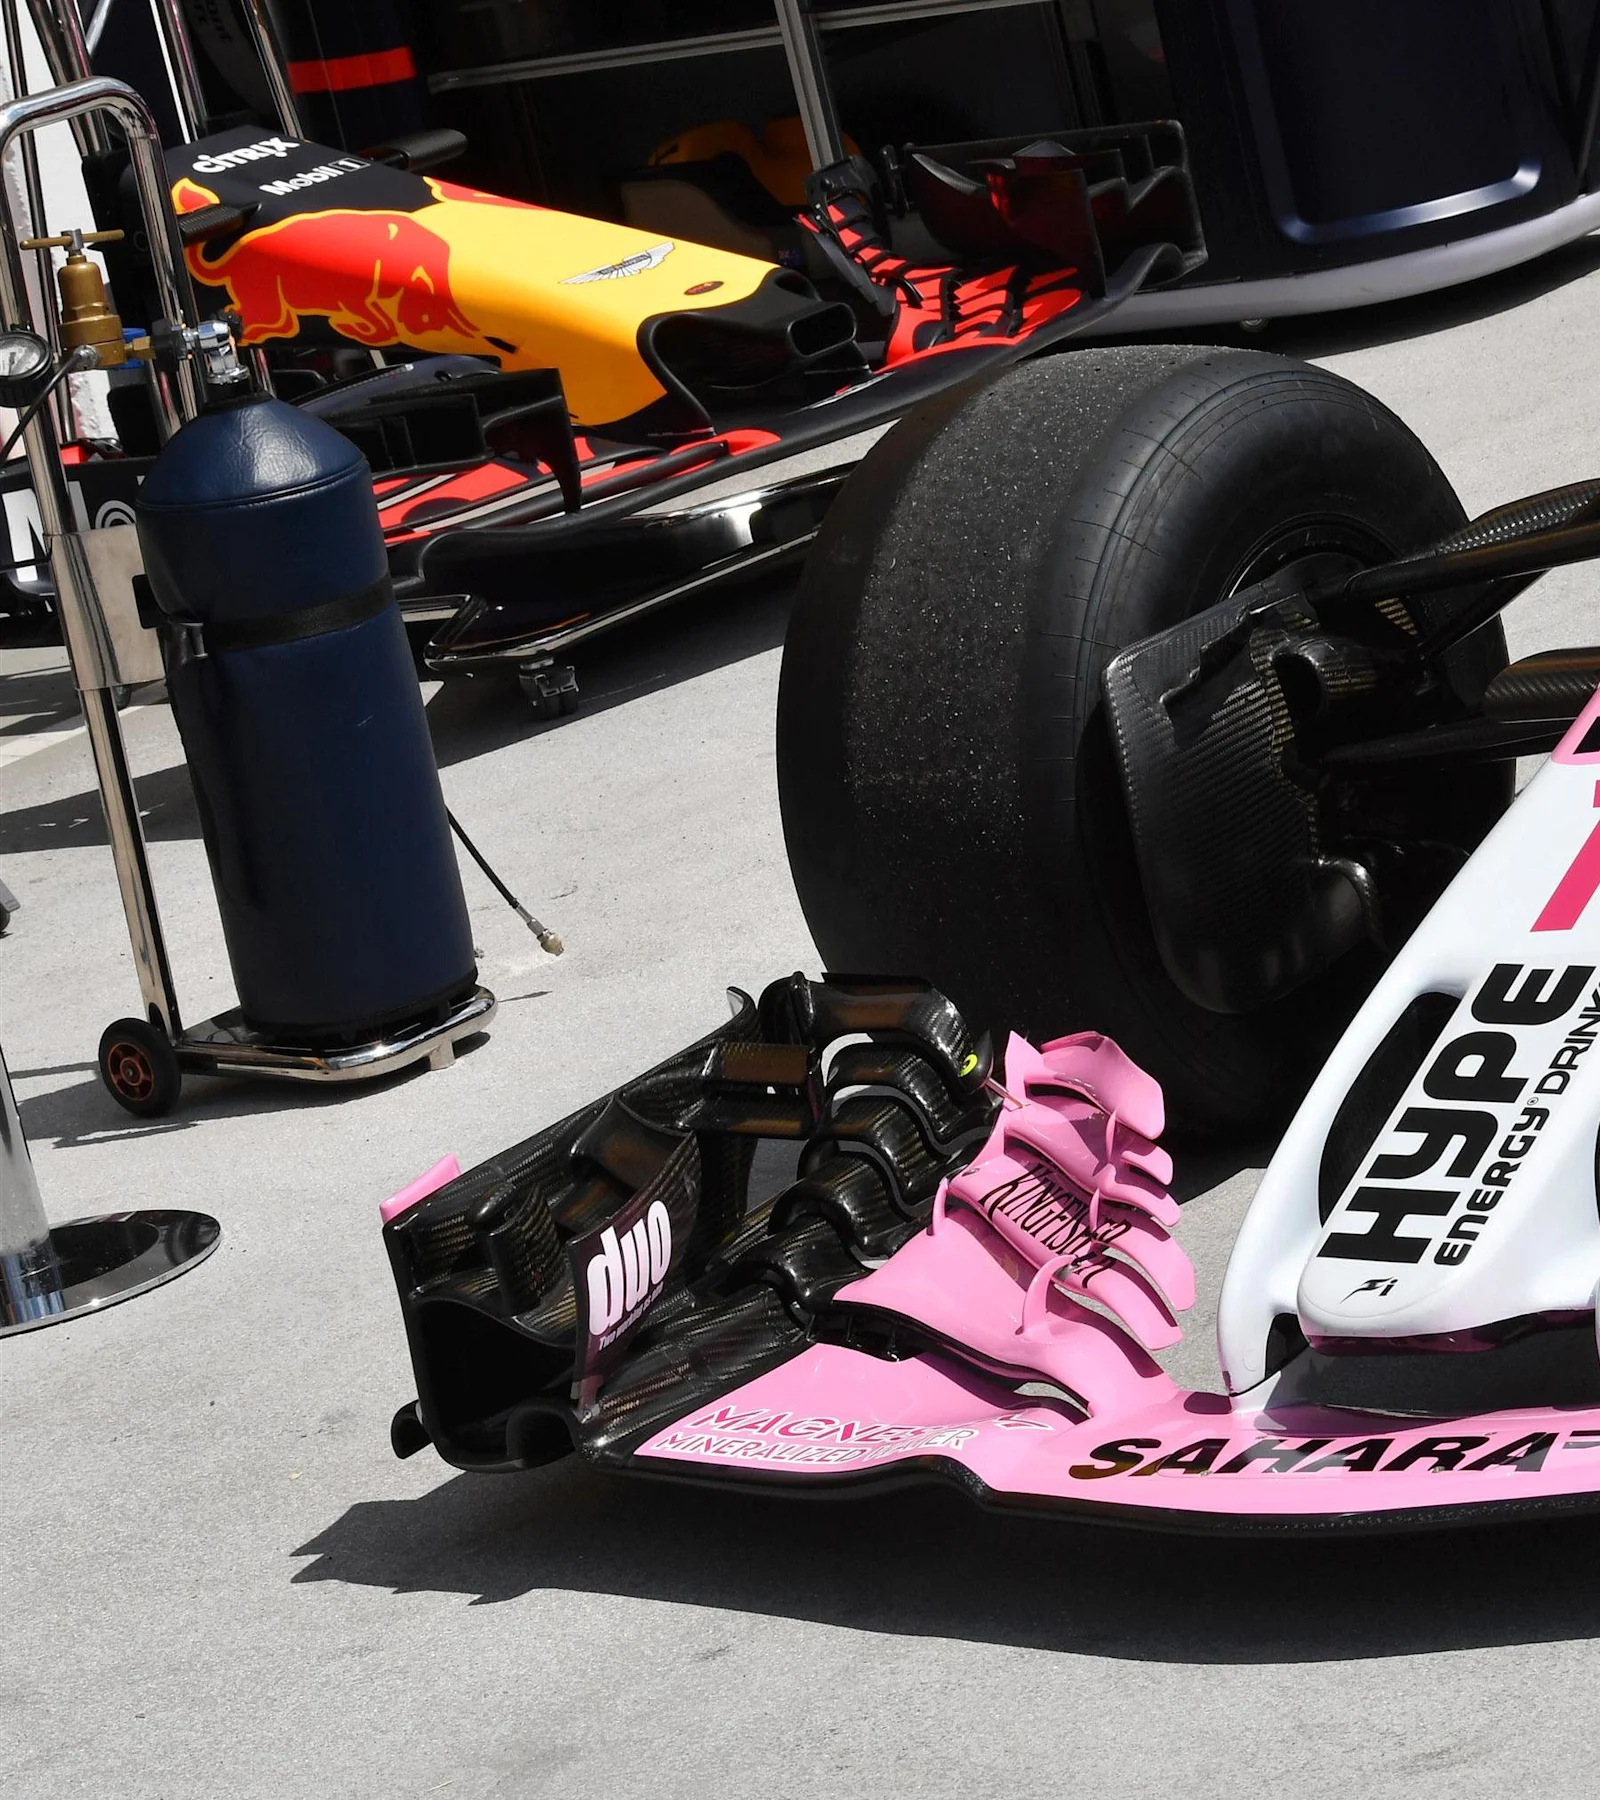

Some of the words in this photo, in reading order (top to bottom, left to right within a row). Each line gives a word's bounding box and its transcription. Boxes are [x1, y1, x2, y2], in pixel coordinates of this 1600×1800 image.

[259, 166, 345, 196] Mobil
[1317, 963, 1597, 1264] HYPE
[1434, 1107, 1550, 1267] ENERGY
[586, 1200, 672, 1336] duo
[651, 1431, 867, 1464] MINERALIZED
[1069, 1429, 1547, 1480] SAHARA
